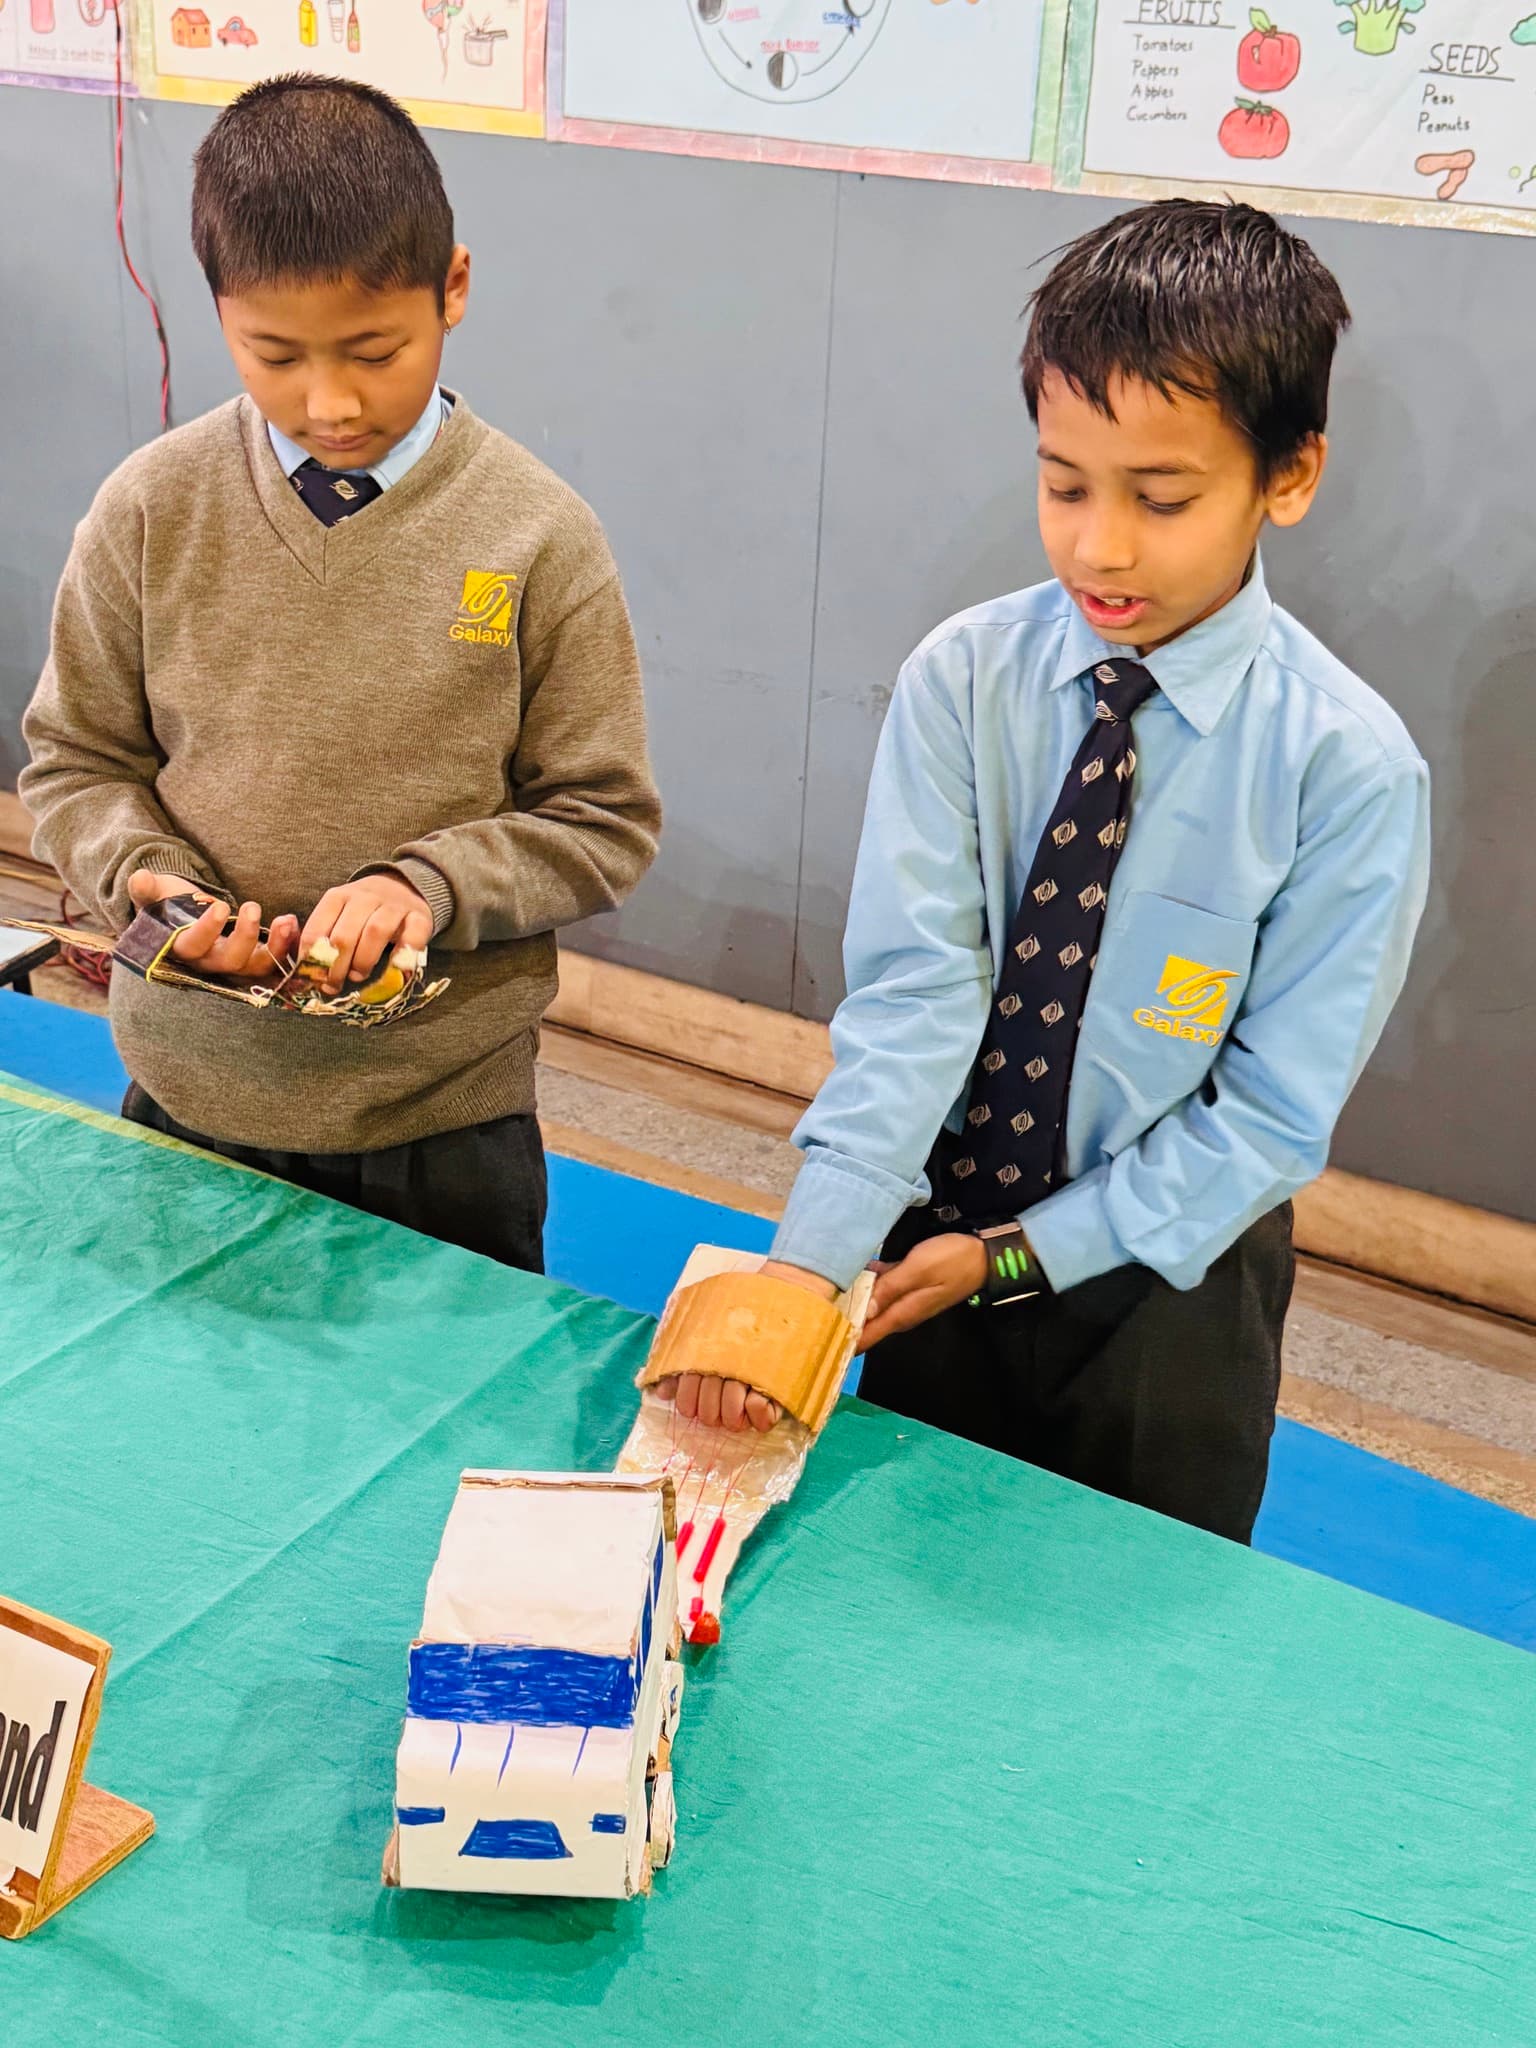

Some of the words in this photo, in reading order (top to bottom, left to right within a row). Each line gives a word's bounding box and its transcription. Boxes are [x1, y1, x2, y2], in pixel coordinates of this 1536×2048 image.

[1138, 0, 1222, 25] FRUITS
[1133, 33, 1193, 52] Tomatoes
[1132, 59, 1180, 80] Peppers
[1428, 42, 1502, 75] SEEDS
[1131, 83, 1174, 100] Apples
[1422, 83, 1455, 105] Peas
[1126, 105, 1187, 121] Cucumbers
[1417, 111, 1471, 133] Peanuts
[449, 623, 513, 648] Galaxy
[1132, 1008, 1224, 1047] Galaxy
[0, 1700, 67, 1832] nd
